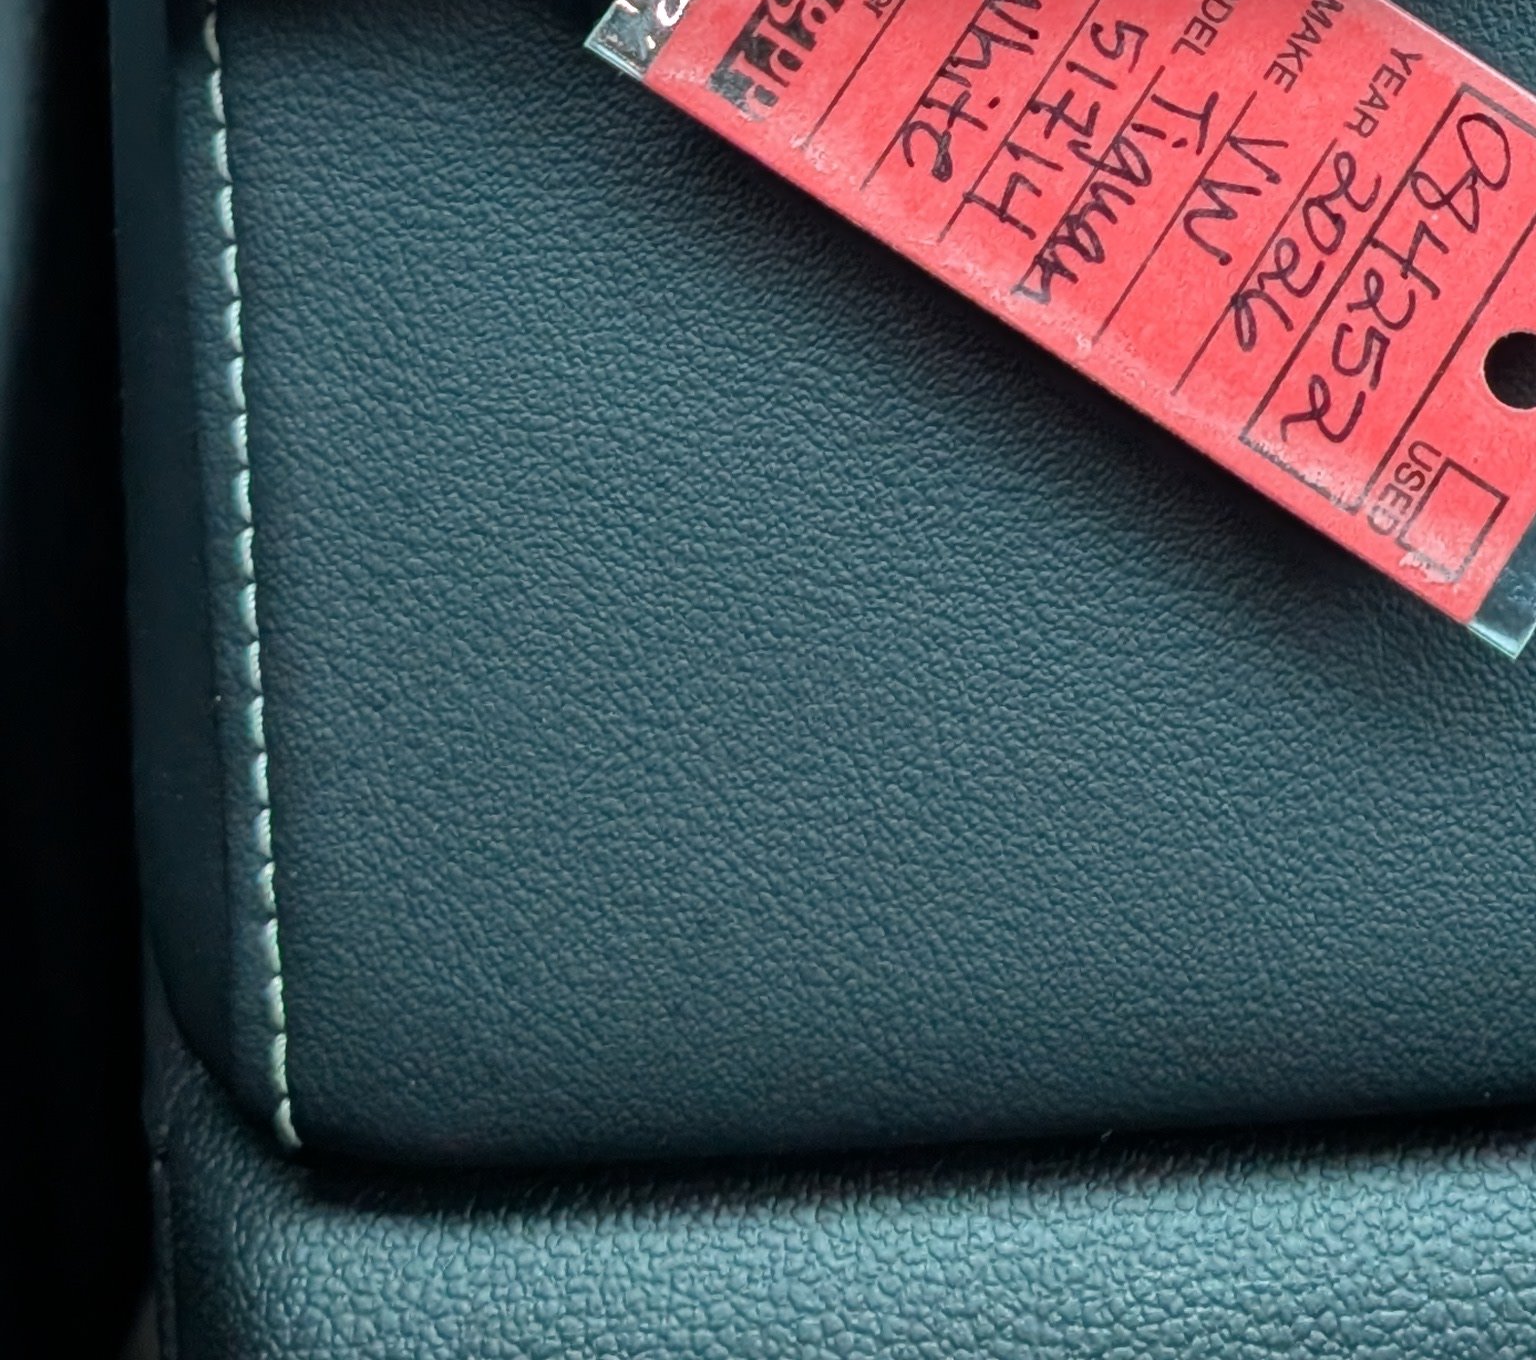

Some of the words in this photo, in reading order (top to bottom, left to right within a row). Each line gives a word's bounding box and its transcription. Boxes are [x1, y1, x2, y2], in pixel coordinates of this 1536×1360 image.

[963, 19, 1149, 241] 51714
[1343, 47, 1424, 139] YEAR
[1010, 90, 1218, 305] Tiguan
[1183, 135, 1290, 267] VW
[1231, 151, 1382, 352] 2026
[1281, 112, 1512, 444] 084252
[1366, 439, 1443, 537] USED
